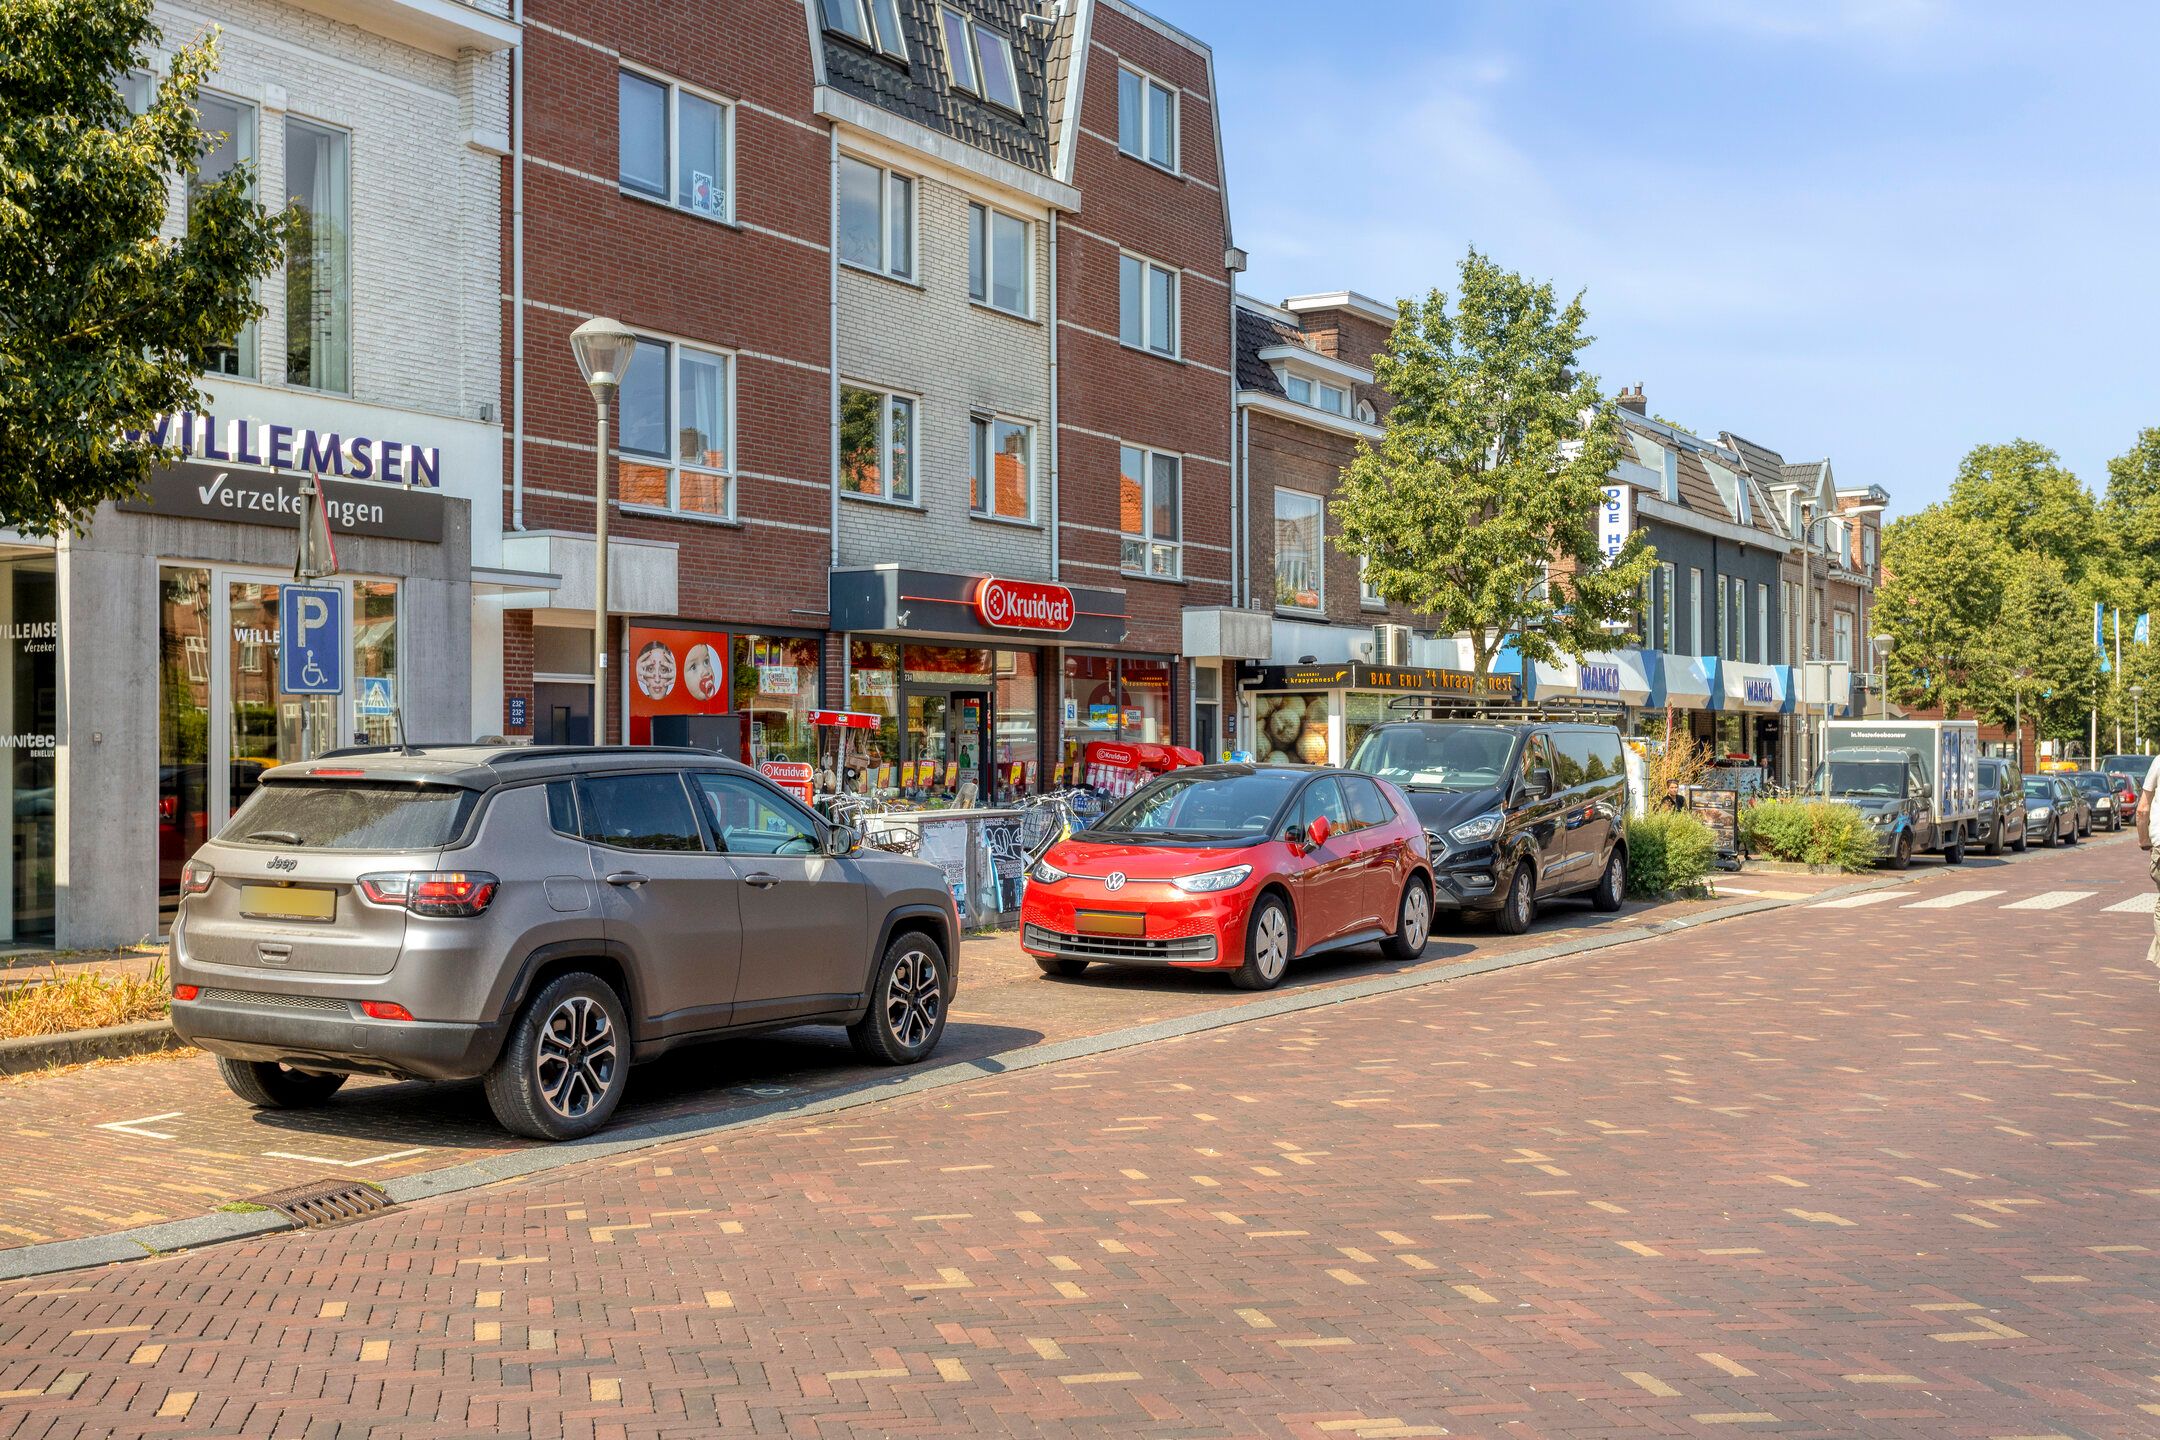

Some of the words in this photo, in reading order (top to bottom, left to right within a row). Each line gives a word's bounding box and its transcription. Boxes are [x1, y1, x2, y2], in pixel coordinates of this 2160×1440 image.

[198, 472, 384, 528] Verzekengen
[1007, 591, 1069, 621] Kruidvat
[0, 622, 57, 640] ILLEMSE
[297, 595, 329, 648] P
[904, 673, 913, 682] 234
[1441, 669, 1513, 695] kraaynest
[1580, 666, 1620, 693] WANCO
[1745, 680, 1773, 703] WANCO
[30, 749, 55, 758] BENELUX
[1104, 752, 1128, 762] Kruidvat
[773, 766, 809, 778] Kruidvat
[266, 856, 298, 873] Jeep
